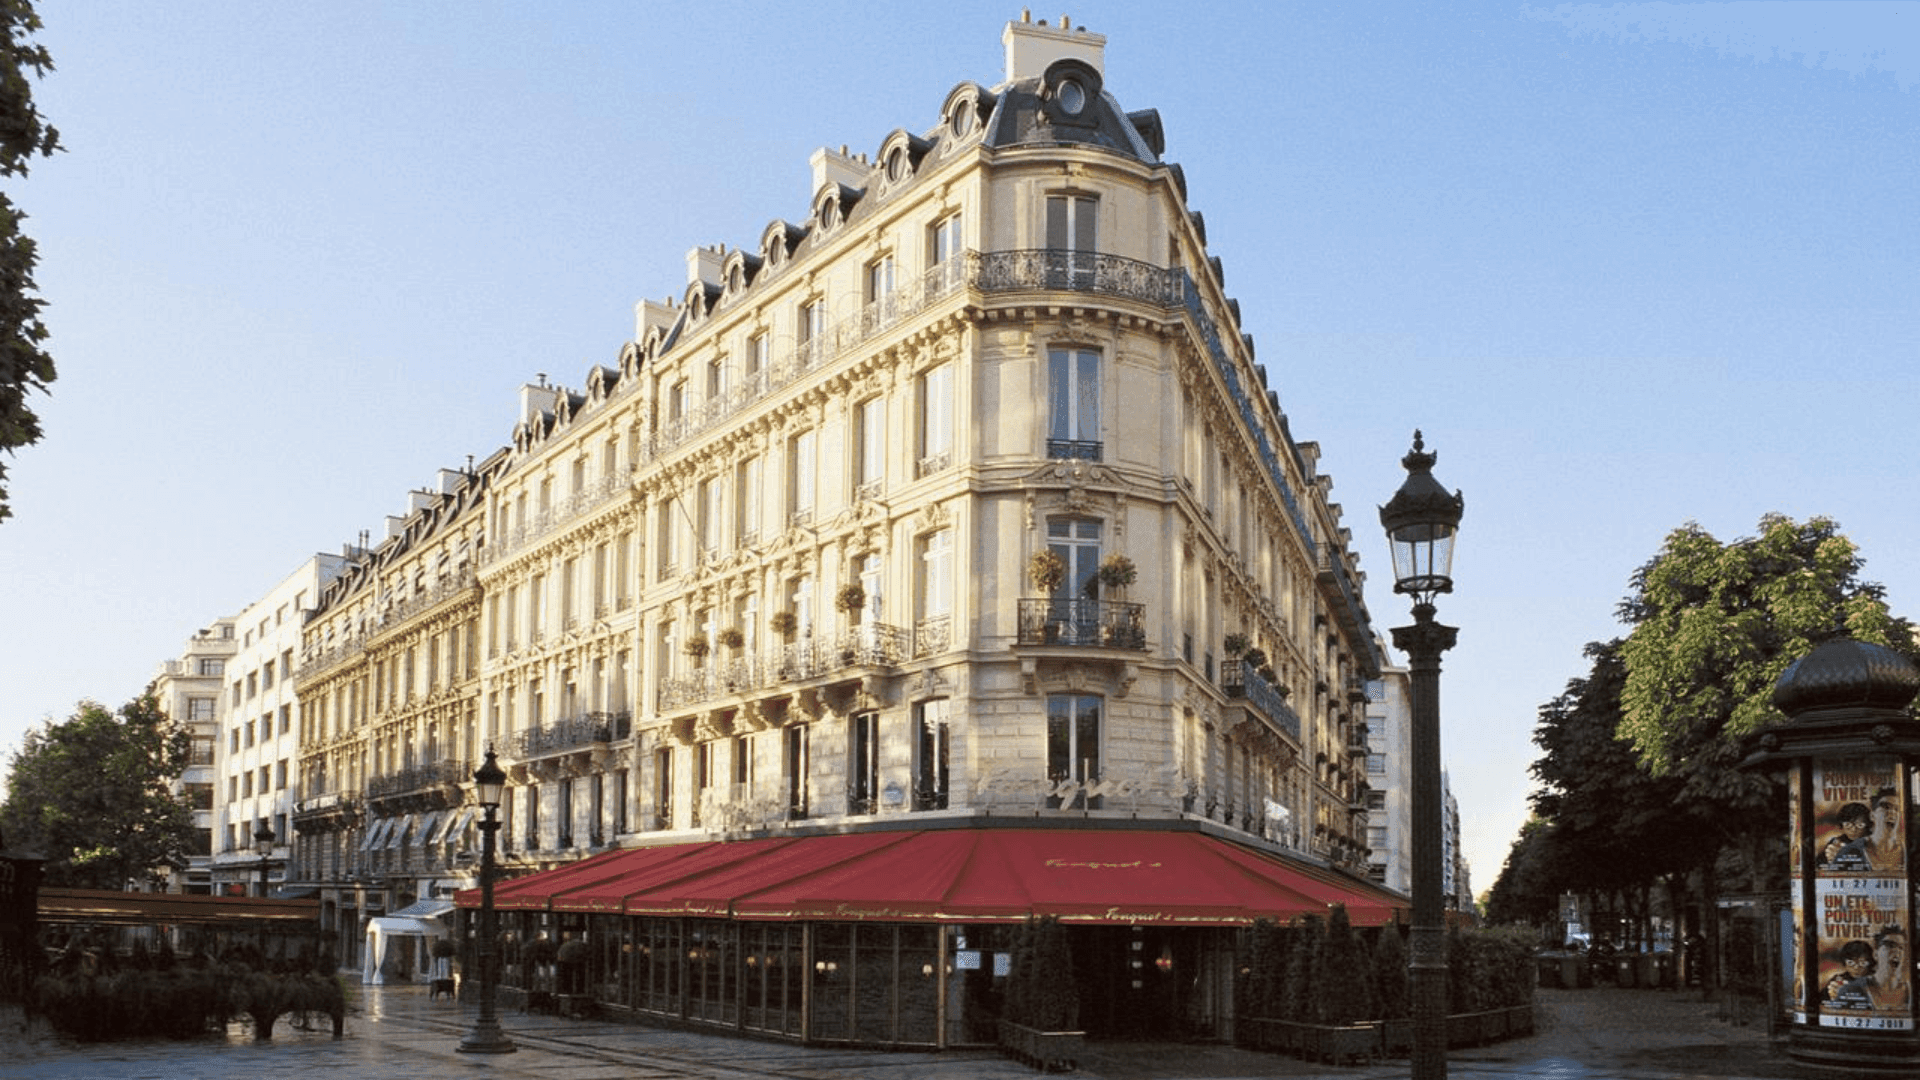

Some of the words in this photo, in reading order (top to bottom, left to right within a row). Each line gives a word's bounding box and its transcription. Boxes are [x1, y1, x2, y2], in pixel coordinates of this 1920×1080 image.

[1823, 787, 1868, 801] VIVRE
[1824, 910, 1862, 923] POUR
[1865, 910, 1897, 924] TOUT
[1825, 924, 1870, 938] VIVRE
